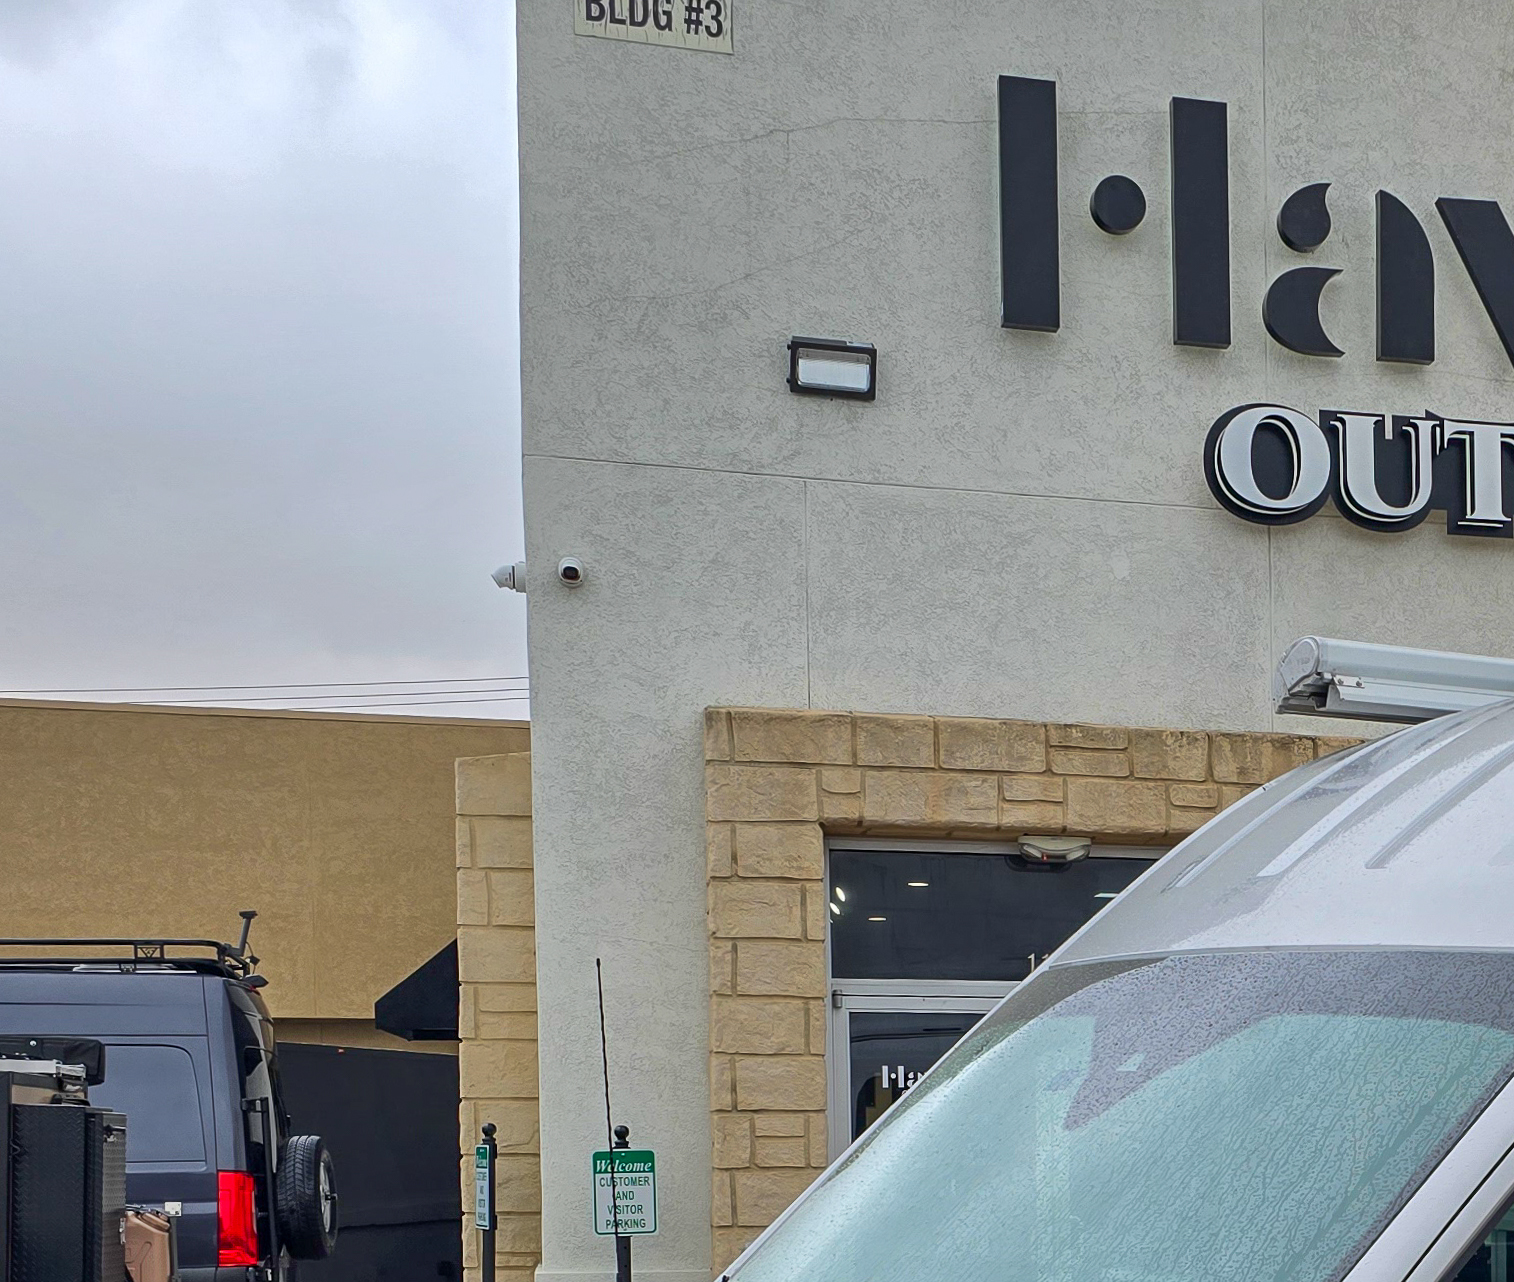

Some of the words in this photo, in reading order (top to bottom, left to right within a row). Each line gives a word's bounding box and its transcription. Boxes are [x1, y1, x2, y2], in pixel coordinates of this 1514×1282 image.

[585, 0, 673, 32] BLDG
[683, 0, 723, 38] #3
[596, 1160, 652, 1172] Welcome
[599, 1176, 650, 1187] CUSTOMER
[615, 1191, 635, 1200] AND
[607, 1204, 643, 1215] VSITOR
[605, 1218, 646, 1229] PARKING
